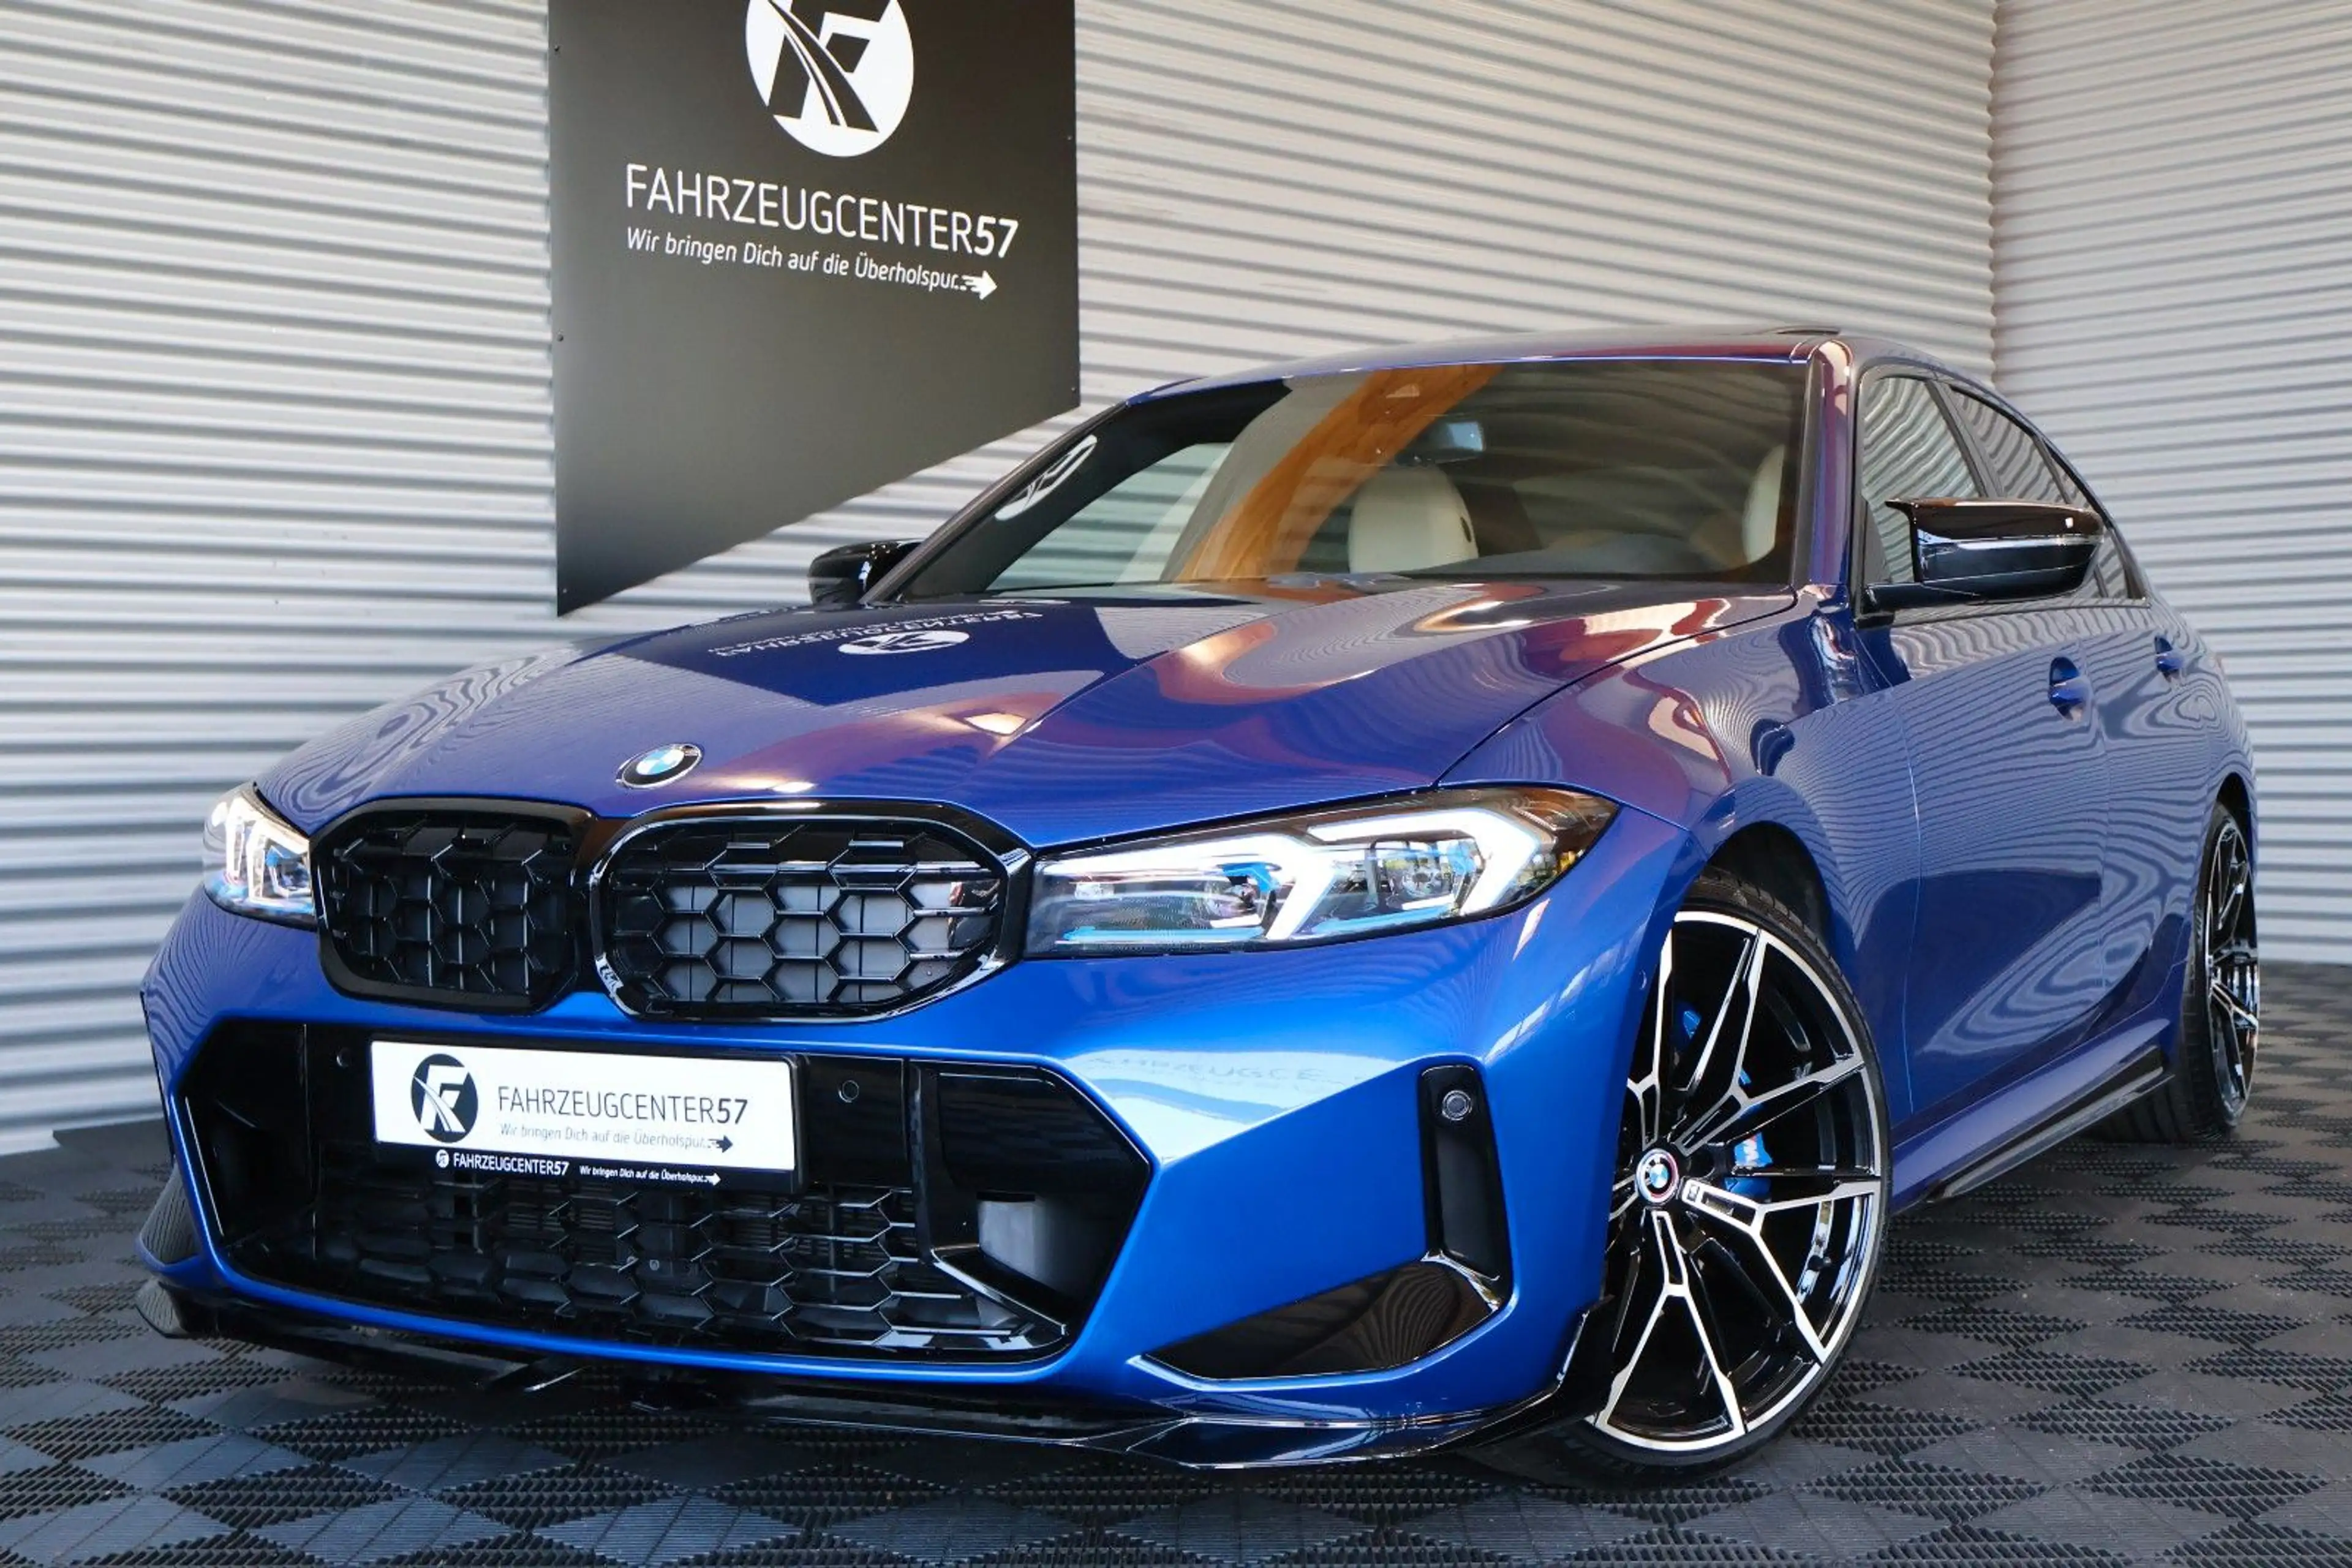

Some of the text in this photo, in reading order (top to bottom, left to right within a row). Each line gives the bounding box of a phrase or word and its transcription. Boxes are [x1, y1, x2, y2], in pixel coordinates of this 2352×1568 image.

[625, 163, 1019, 258] FAHRZEUGCENTER57
[627, 227, 659, 252] Wir
[665, 232, 736, 265] bringen
[743, 242, 782, 268] Dich
[788, 251, 818, 272] auf
[823, 252, 848, 276] die
[498, 1085, 748, 1125] FAHRZEUGCENTER57
[500, 1122, 518, 1137] Wir
[521, 1125, 561, 1142] bringen
[565, 1127, 588, 1142] Dich
[592, 1129, 611, 1143] auf
[614, 1130, 631, 1144] die
[453, 1153, 570, 1176] FAHRZEUGCENTER57
[579, 1165, 592, 1175] Wir
[594, 1166, 619, 1178] bringen
[619, 1167, 634, 1178] Dich
[636, 1169, 647, 1178] auf
[649, 1170, 659, 1180] die
